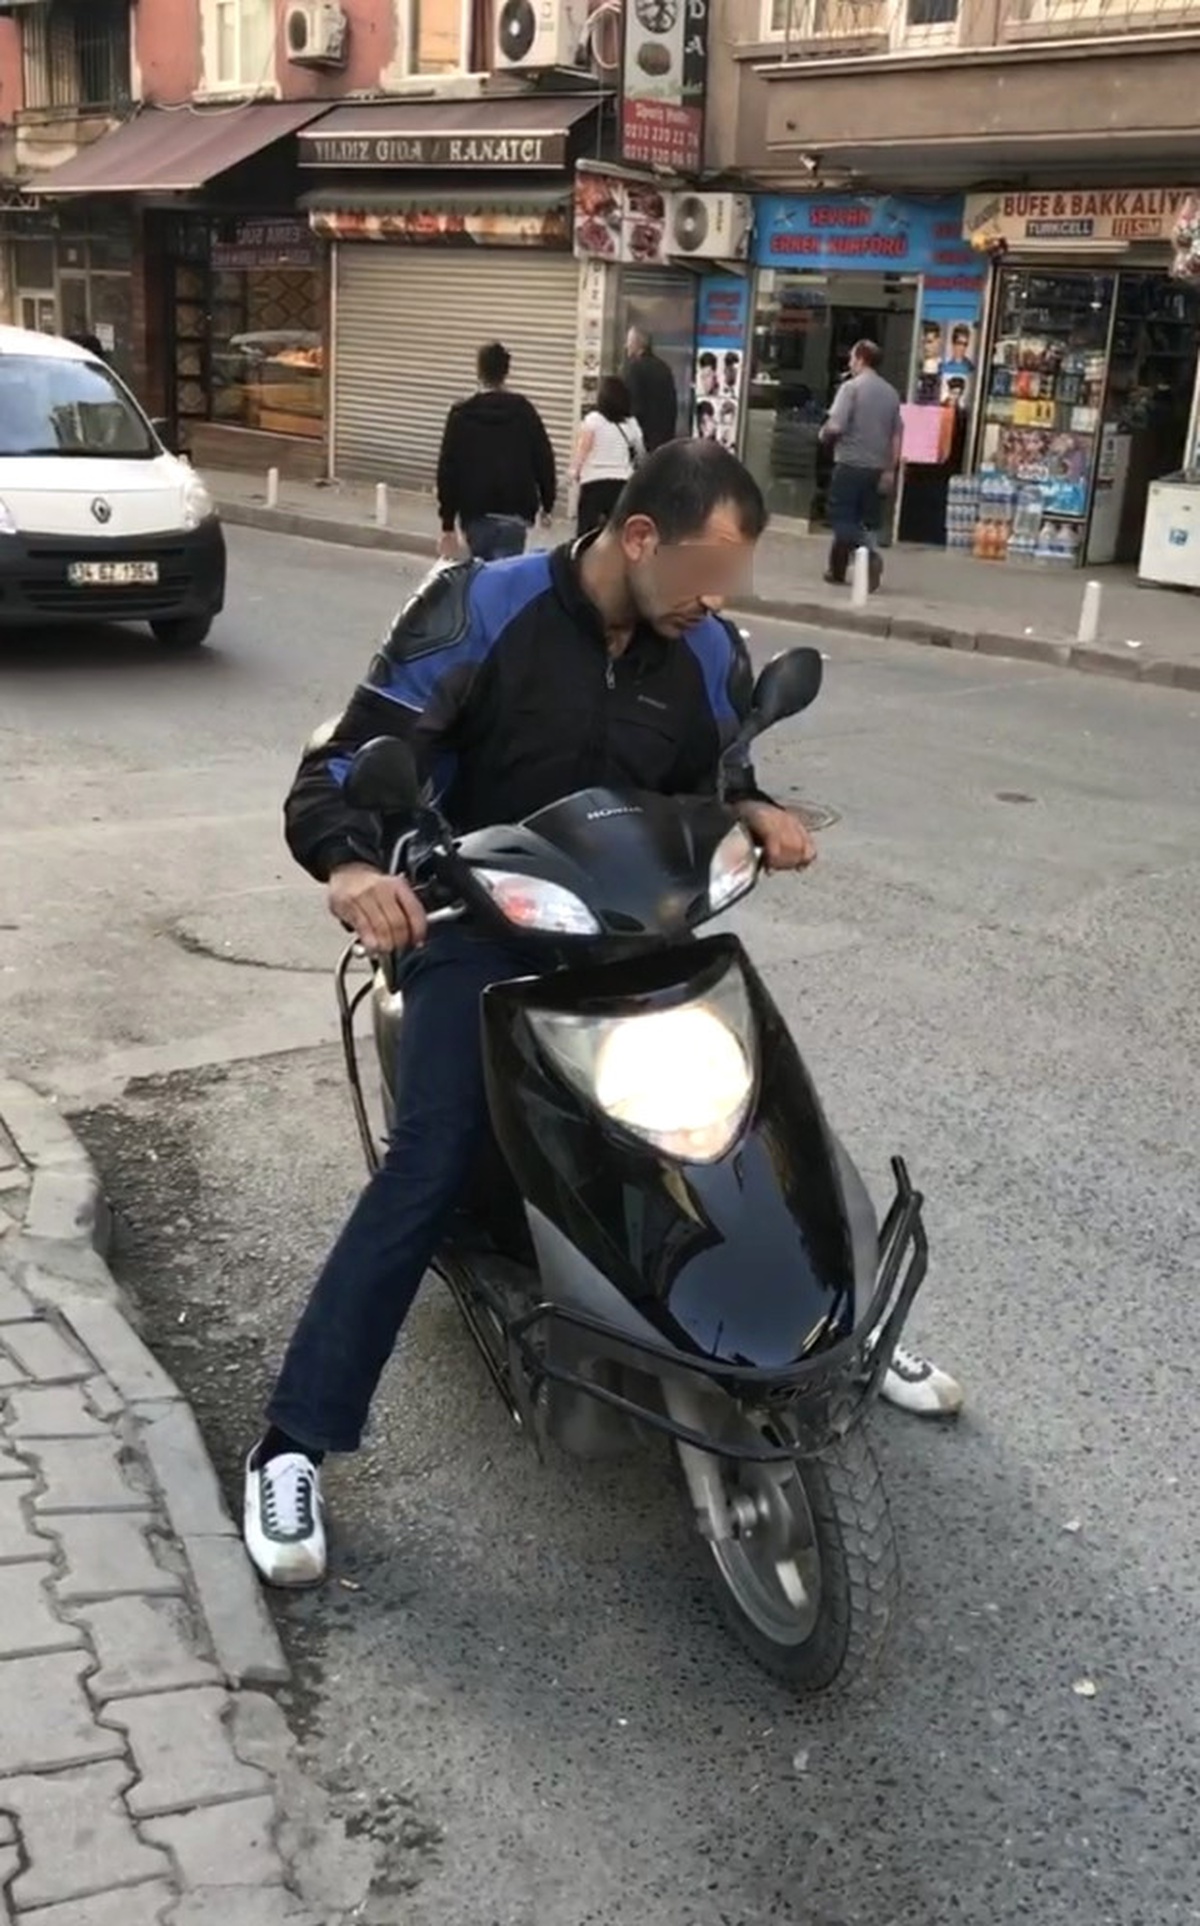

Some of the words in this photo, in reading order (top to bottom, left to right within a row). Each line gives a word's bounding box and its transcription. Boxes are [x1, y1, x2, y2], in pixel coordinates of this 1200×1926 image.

[314, 141, 370, 161] YILDIZ
[375, 140, 423, 161] GIDA
[1052, 193, 1066, 216] &
